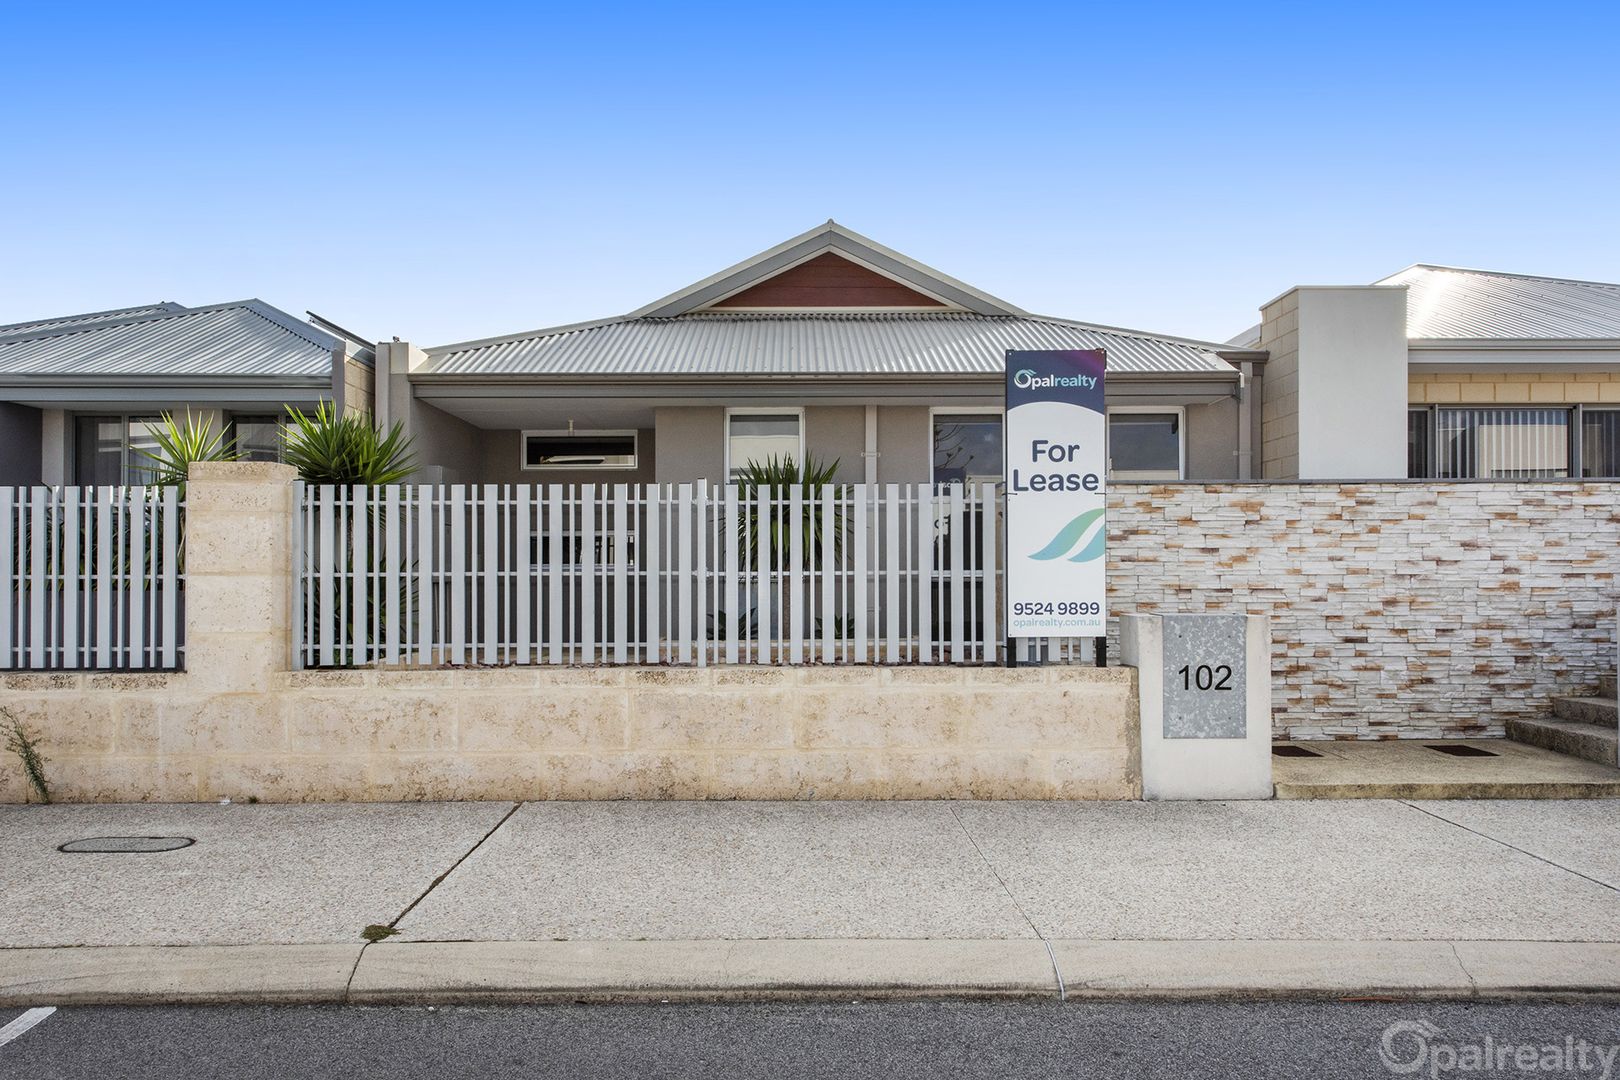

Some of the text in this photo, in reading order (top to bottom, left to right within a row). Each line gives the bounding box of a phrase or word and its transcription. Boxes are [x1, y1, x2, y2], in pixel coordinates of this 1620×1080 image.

[1014, 369, 1097, 390] Opalrealty
[1032, 440, 1080, 462] For
[1013, 469, 1099, 491] Lease
[1014, 602, 1100, 615] 9524 9899
[1013, 618, 1100, 628] opalrealty.com.au
[1178, 664, 1232, 691] 102
